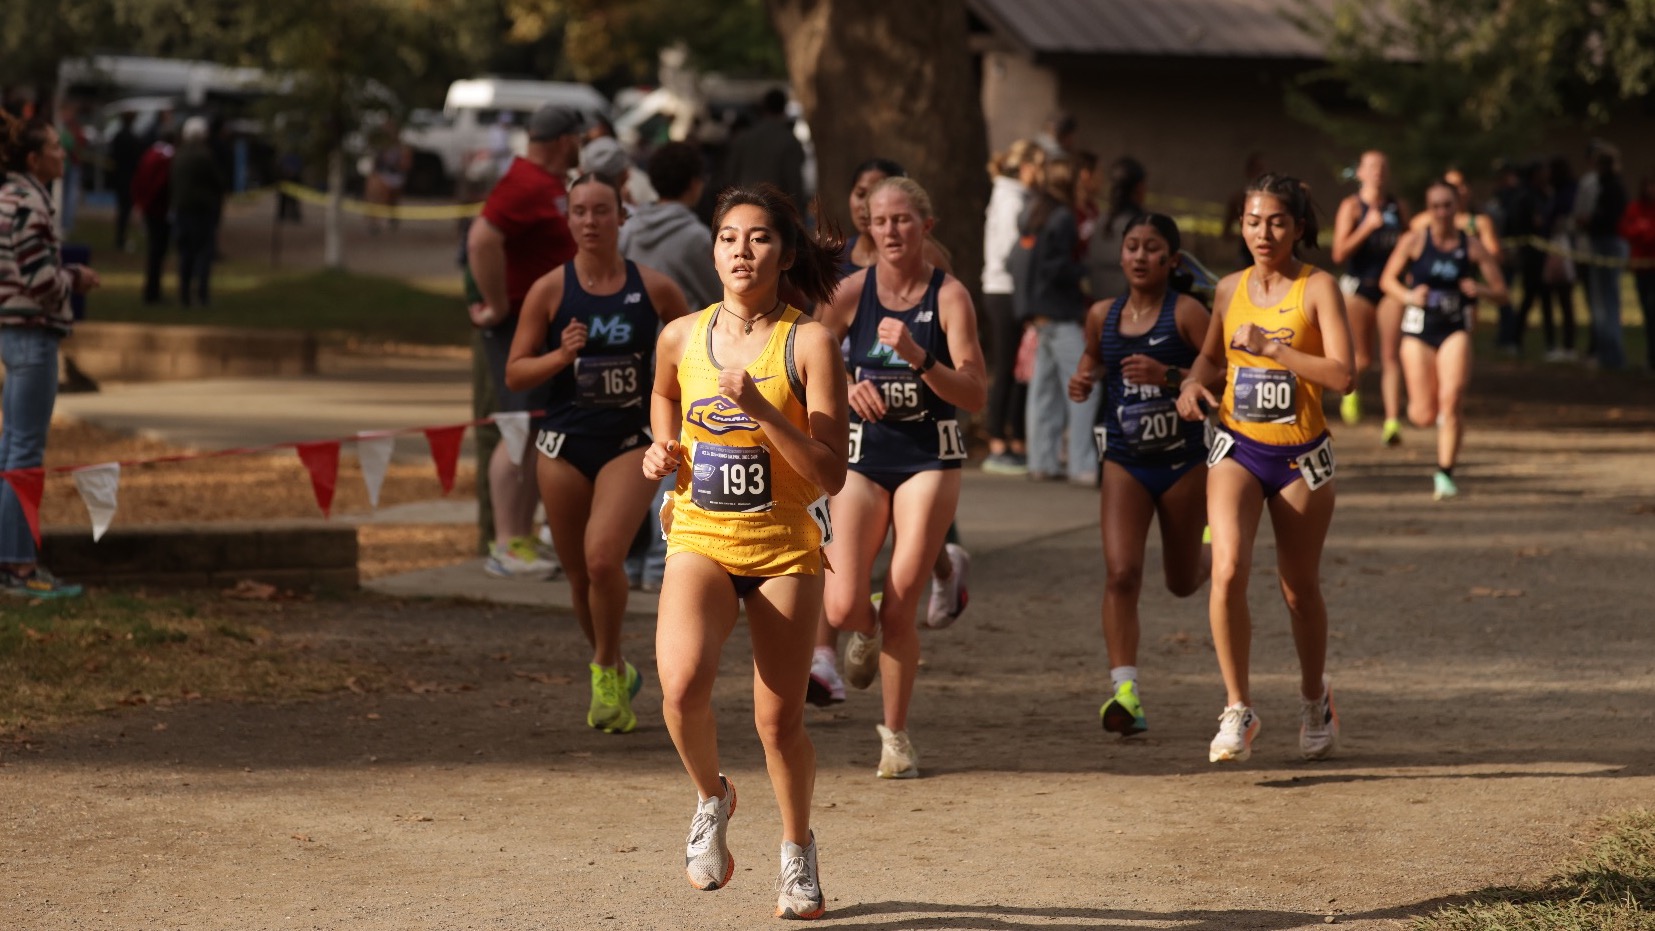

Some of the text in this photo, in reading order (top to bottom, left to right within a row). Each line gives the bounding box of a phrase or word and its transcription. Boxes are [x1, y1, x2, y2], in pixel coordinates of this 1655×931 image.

[589, 315, 633, 345] MB
[914, 311, 933, 323] NB
[602, 367, 637, 394] 163
[881, 382, 918, 408] 165
[1254, 381, 1291, 409] 190
[1140, 411, 1178, 441] 207
[719, 463, 765, 496] 193
